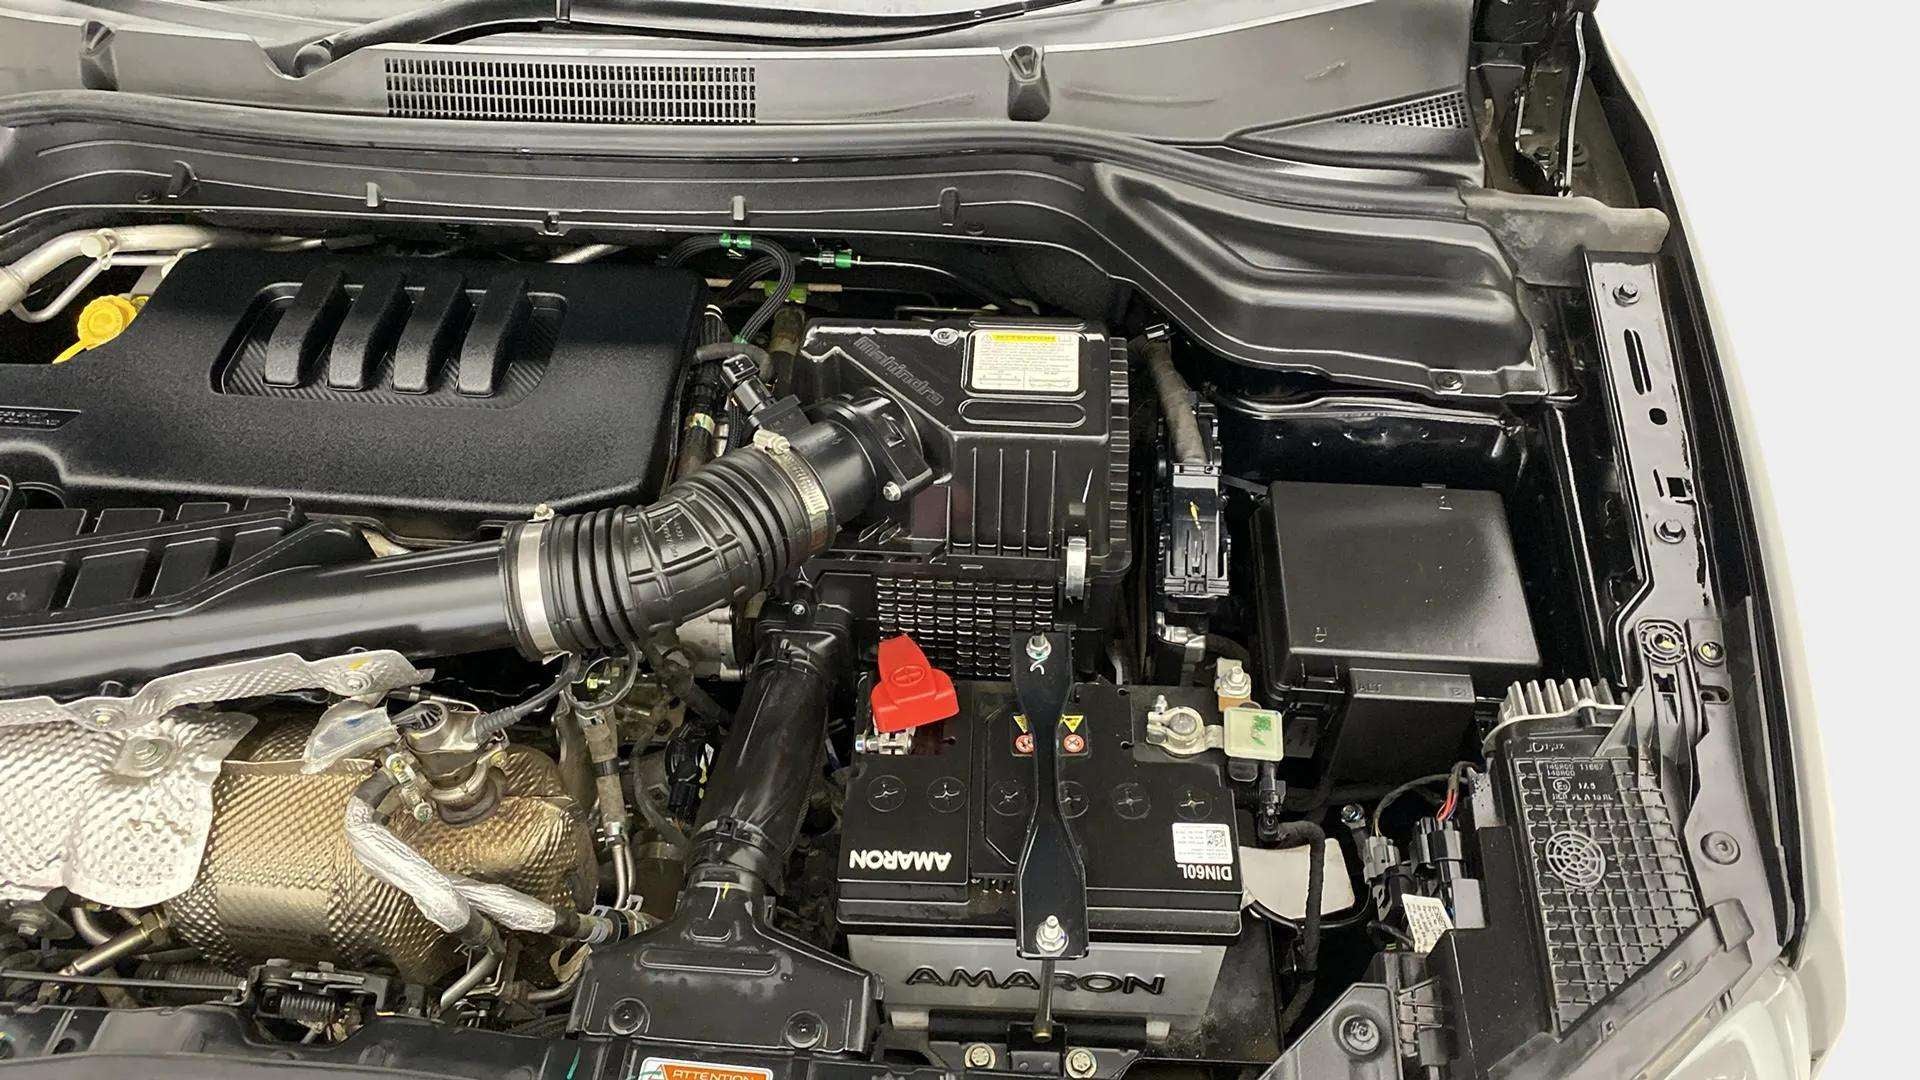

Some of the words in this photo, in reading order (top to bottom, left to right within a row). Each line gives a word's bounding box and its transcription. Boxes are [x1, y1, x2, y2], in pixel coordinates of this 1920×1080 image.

[848, 849, 952, 872] AMARON
[1177, 864, 1233, 881] DIN60L
[905, 966, 1165, 994] AMARON
